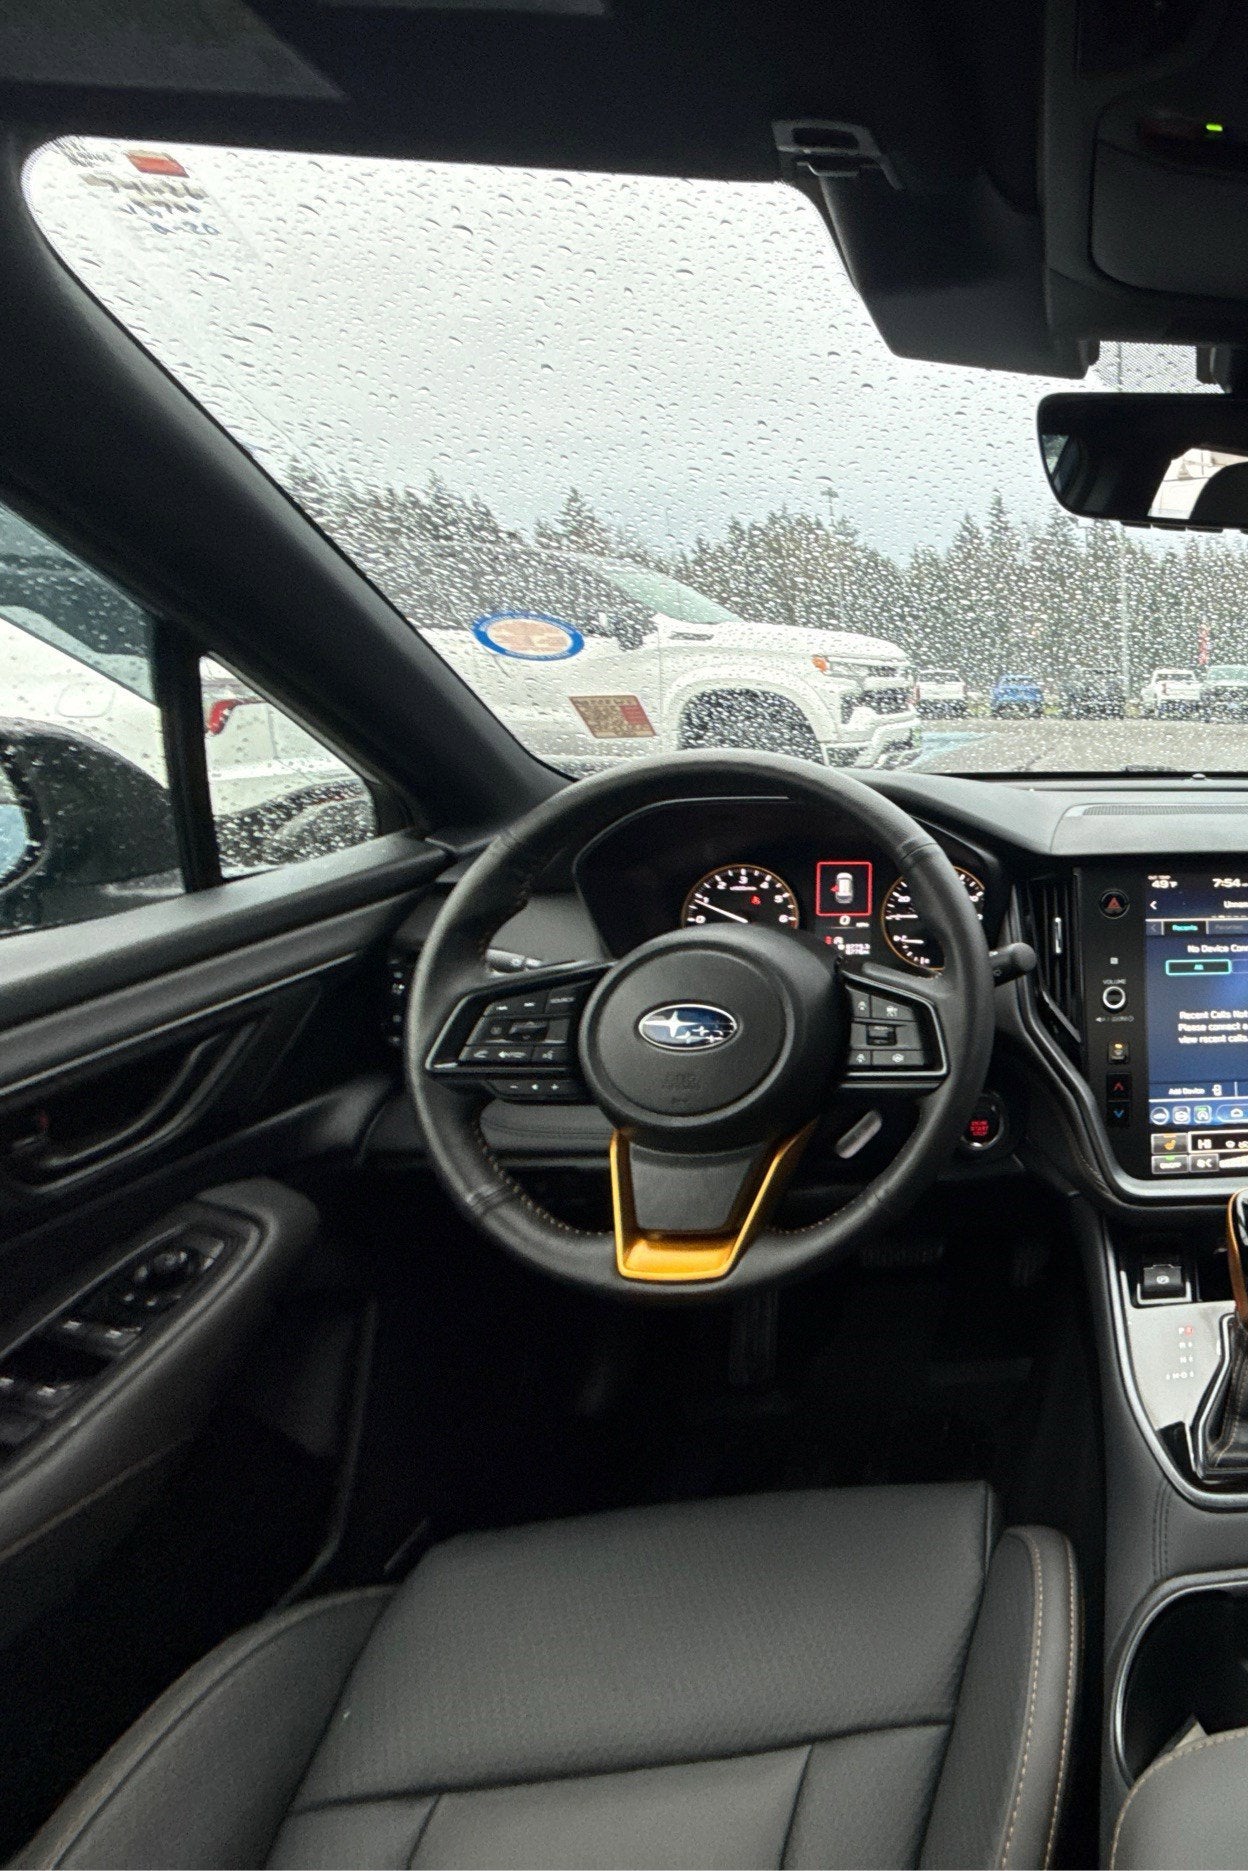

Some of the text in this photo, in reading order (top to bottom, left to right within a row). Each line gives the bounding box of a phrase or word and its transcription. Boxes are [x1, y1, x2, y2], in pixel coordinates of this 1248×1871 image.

[739, 876, 748, 884] 3
[1212, 877, 1241, 888] 7:54
[1187, 944, 1199, 953] No
[1201, 944, 1229, 953] Device
[1179, 1011, 1209, 1020] Recent
[1210, 1010, 1231, 1019] Calls
[1233, 1010, 1248, 1019] Not
[1178, 1023, 1206, 1032] Please
[1208, 1022, 1240, 1031] connect
[1178, 1036, 1198, 1044] view
[1199, 1035, 1226, 1043] recent
[1183, 1087, 1205, 1095] Device
